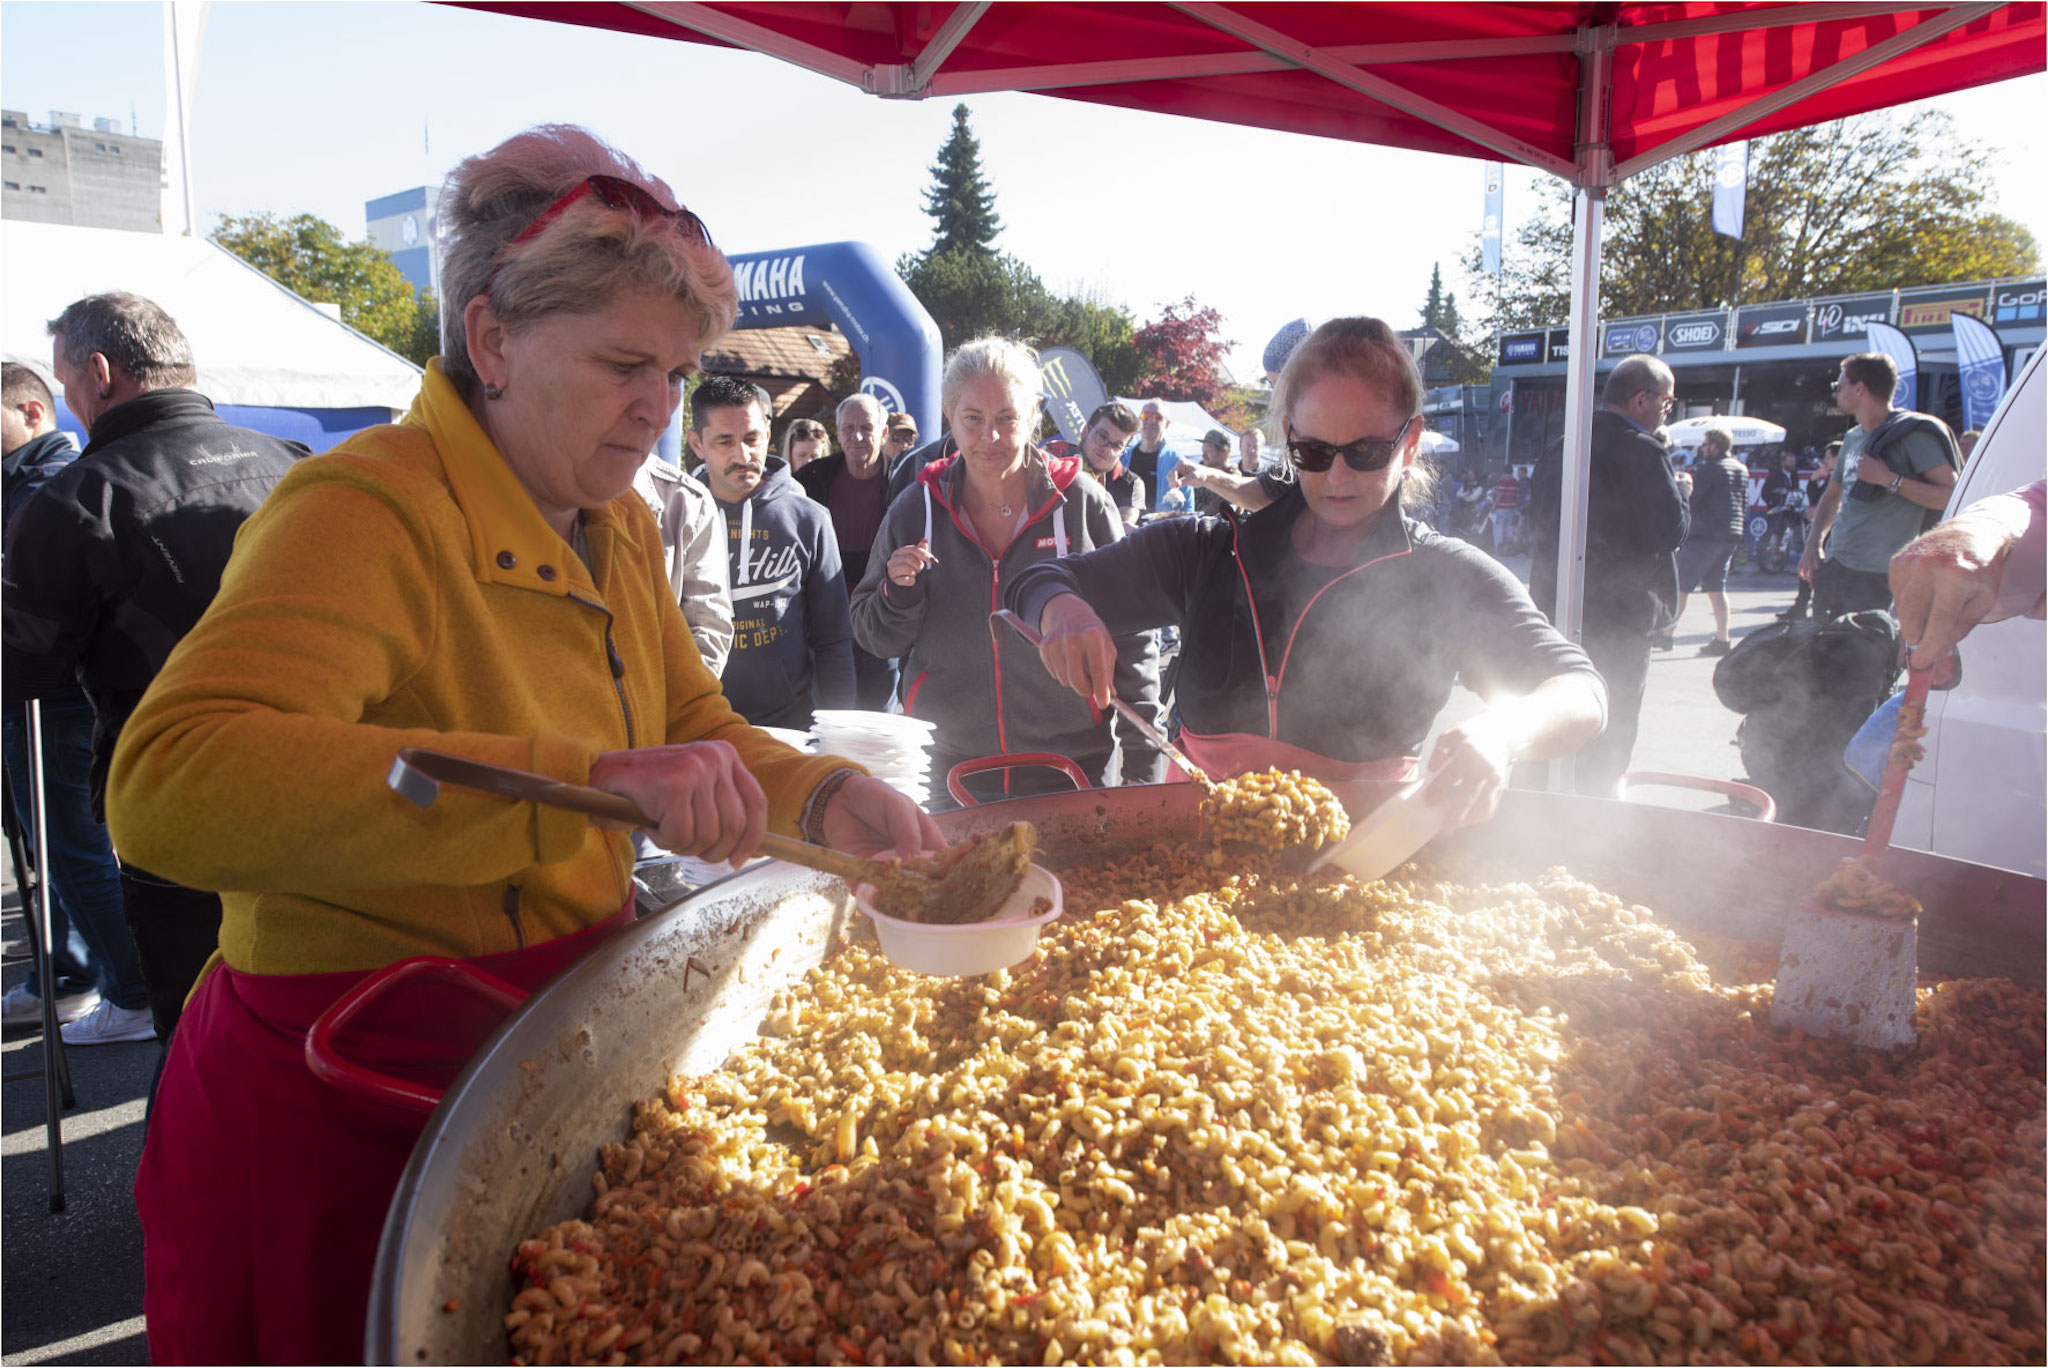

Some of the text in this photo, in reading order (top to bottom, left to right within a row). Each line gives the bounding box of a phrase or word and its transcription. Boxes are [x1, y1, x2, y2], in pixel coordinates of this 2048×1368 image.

[1675, 325, 1713, 343] SHOEI
[189, 450, 258, 466] CALIFORNIA
[732, 618, 766, 631] RIGINAL
[733, 633, 748, 649] IC
